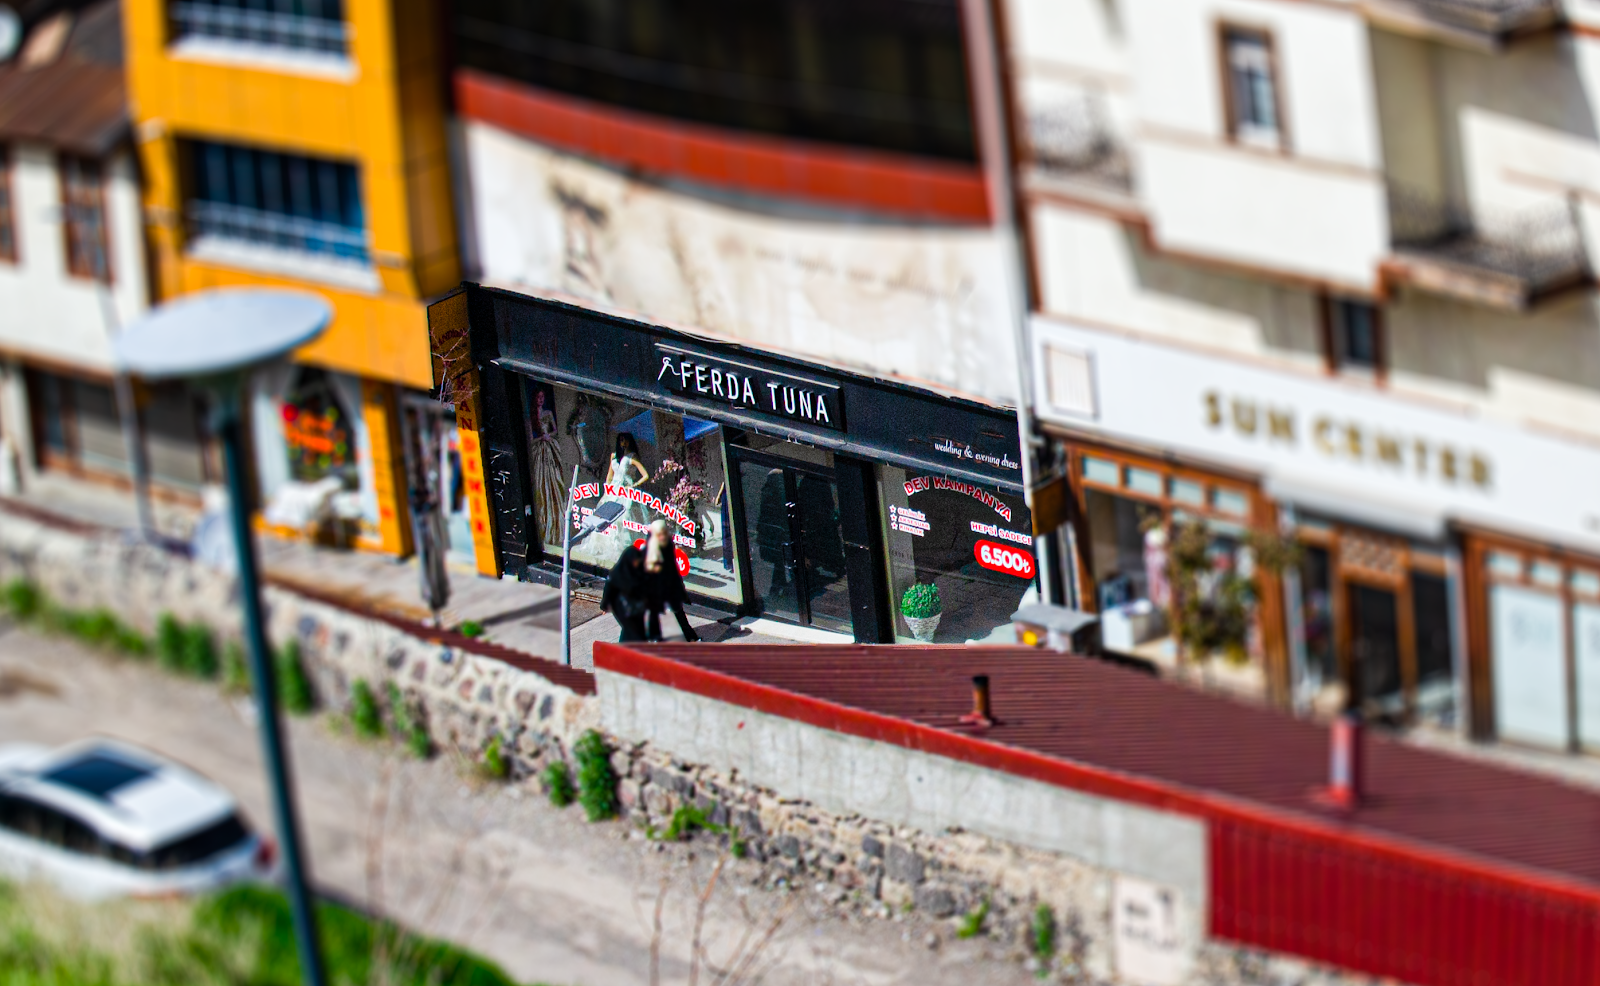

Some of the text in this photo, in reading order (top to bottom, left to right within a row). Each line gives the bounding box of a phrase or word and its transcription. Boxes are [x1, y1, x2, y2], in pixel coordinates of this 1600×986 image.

[680, 361, 830, 423] FERDA TUNA
[935, 440, 1018, 469] wedding & evening dress
[1203, 388, 1492, 488] SUN CENTER
[569, 483, 697, 536] DEV KAMPANYA
[903, 476, 1012, 523] DEV KAMPANYA
[622, 519, 650, 535] HEPS
[971, 521, 1032, 545] HEPSİ SADECE
